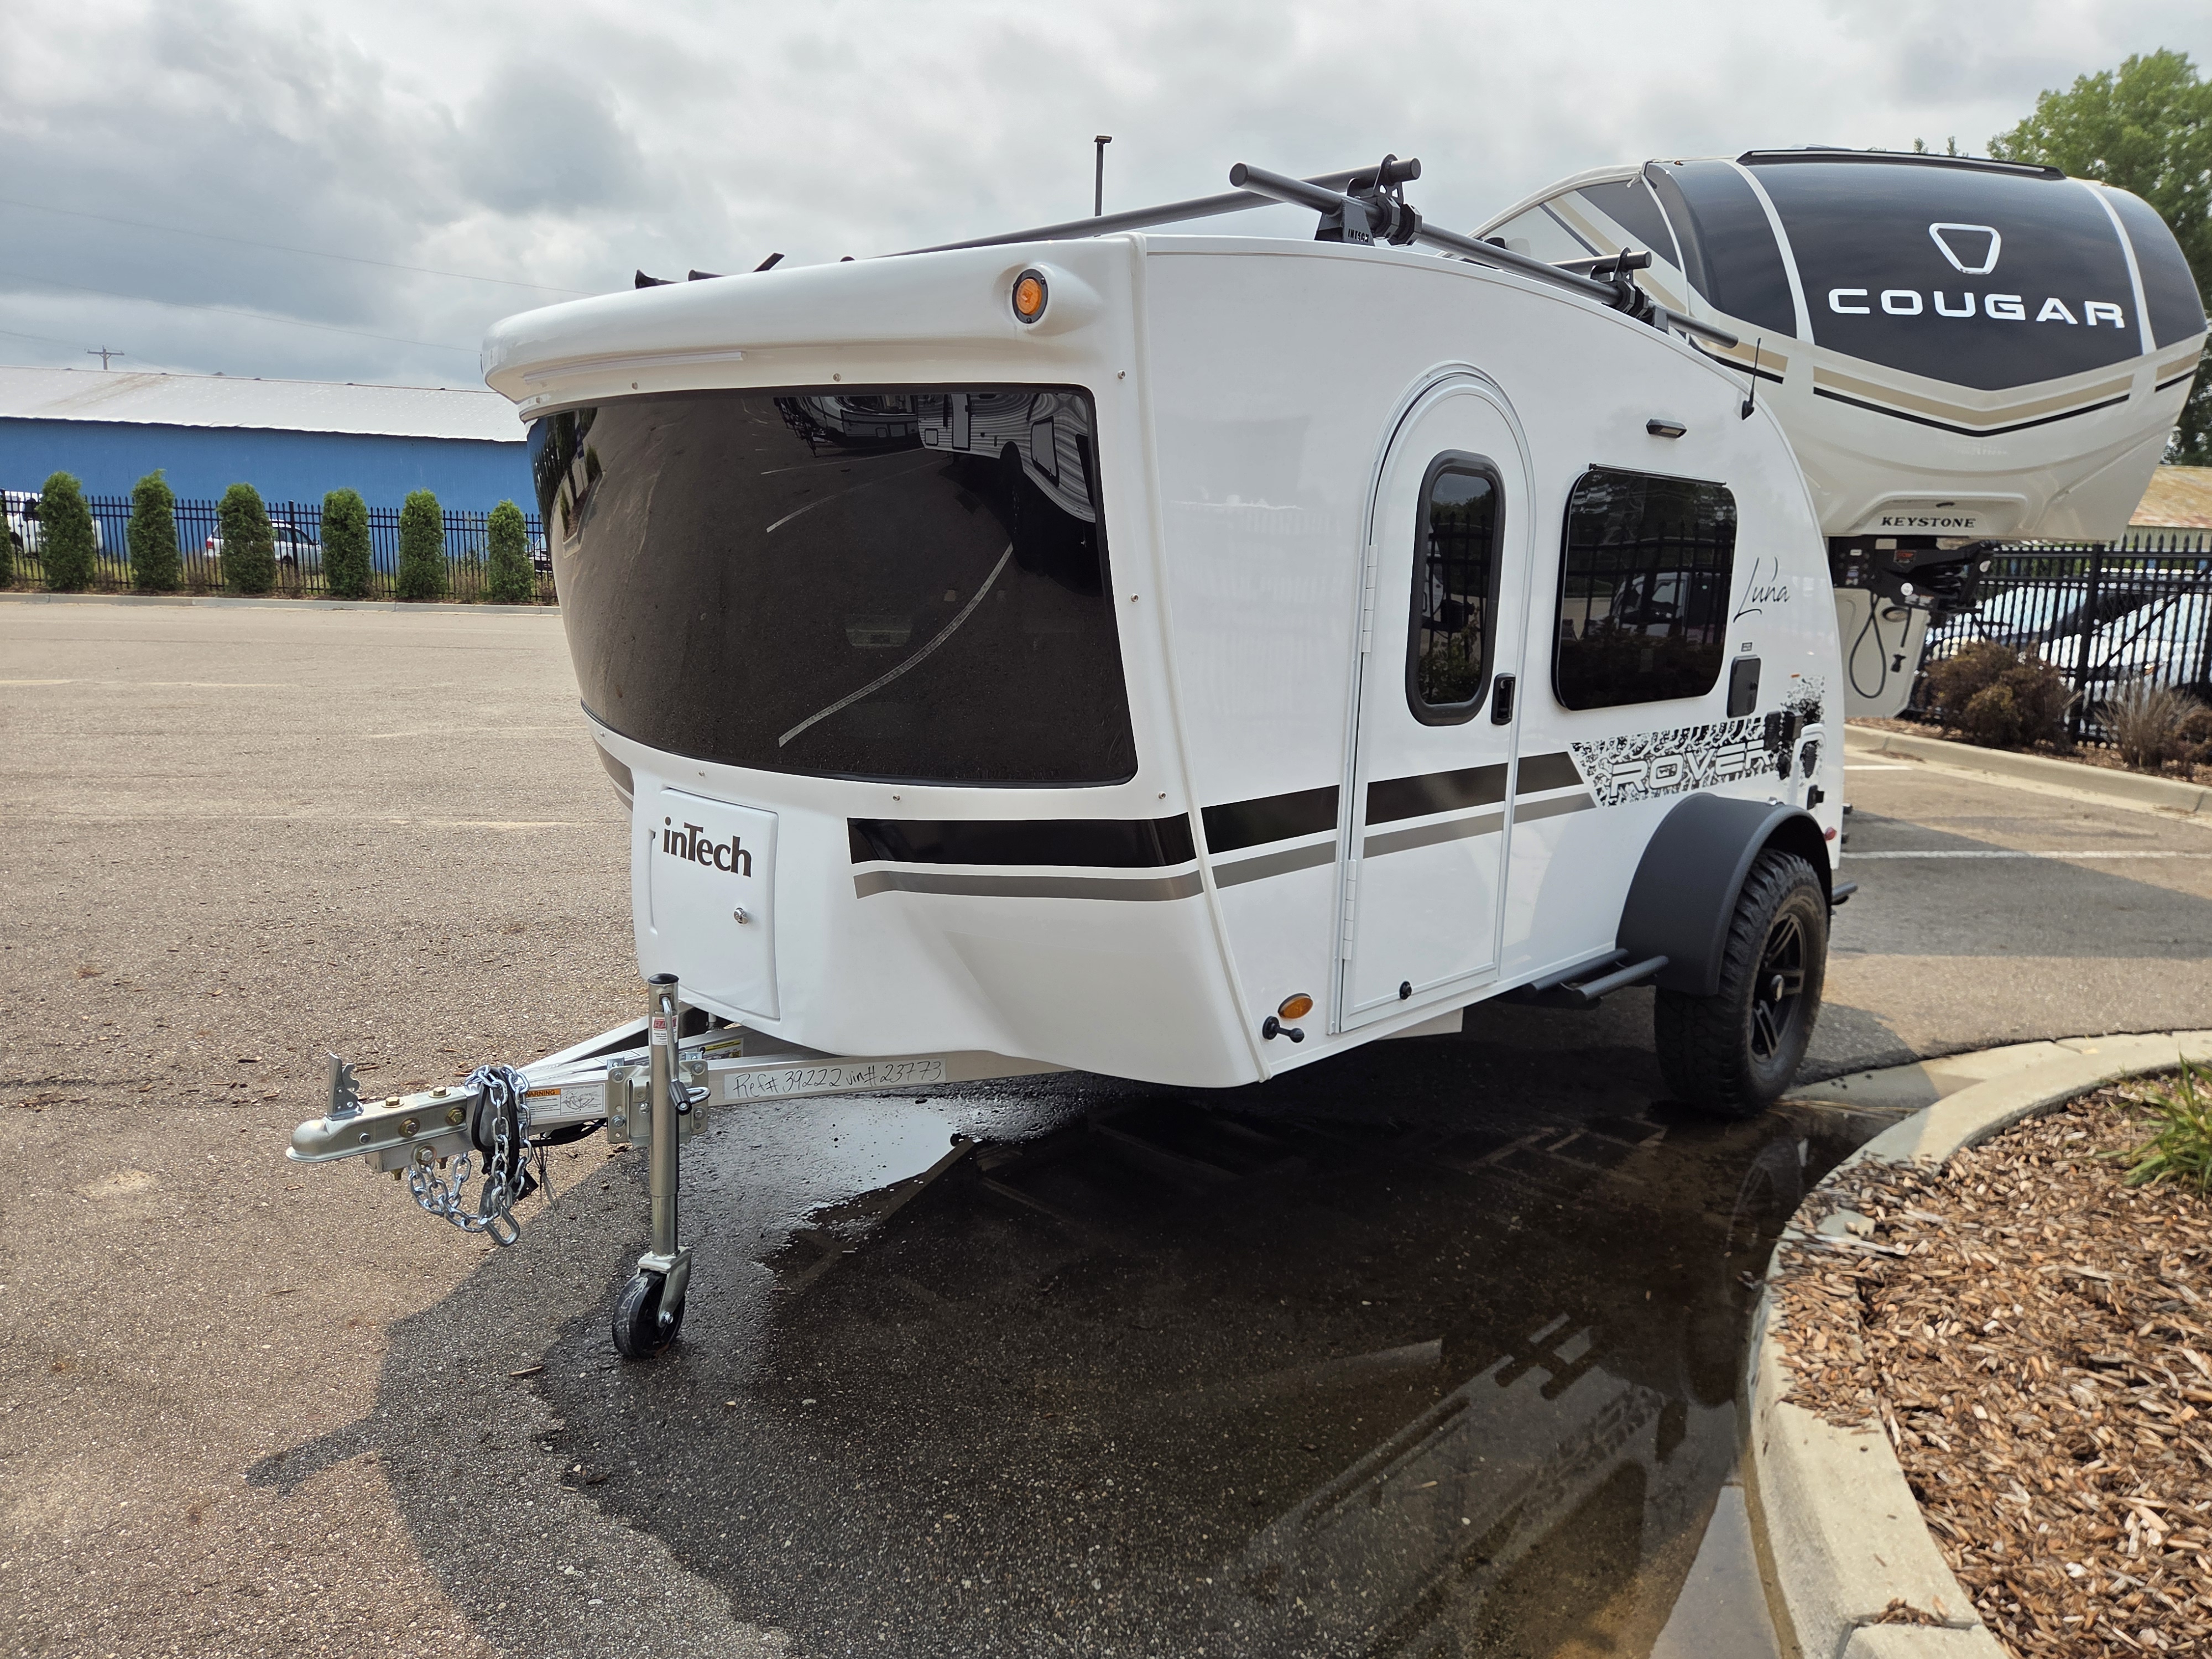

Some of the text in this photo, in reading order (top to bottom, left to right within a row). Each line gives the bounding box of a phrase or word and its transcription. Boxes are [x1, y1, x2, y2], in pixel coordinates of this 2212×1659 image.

[1828, 288, 2125, 328] COUGAR
[1881, 516, 1976, 528] KEYSTONE
[1733, 556, 1791, 623] Luna
[1610, 739, 1772, 797] ROVER
[663, 816, 752, 878] inTech
[782, 1068, 842, 1092] 39222
[880, 1061, 941, 1082] 23773
